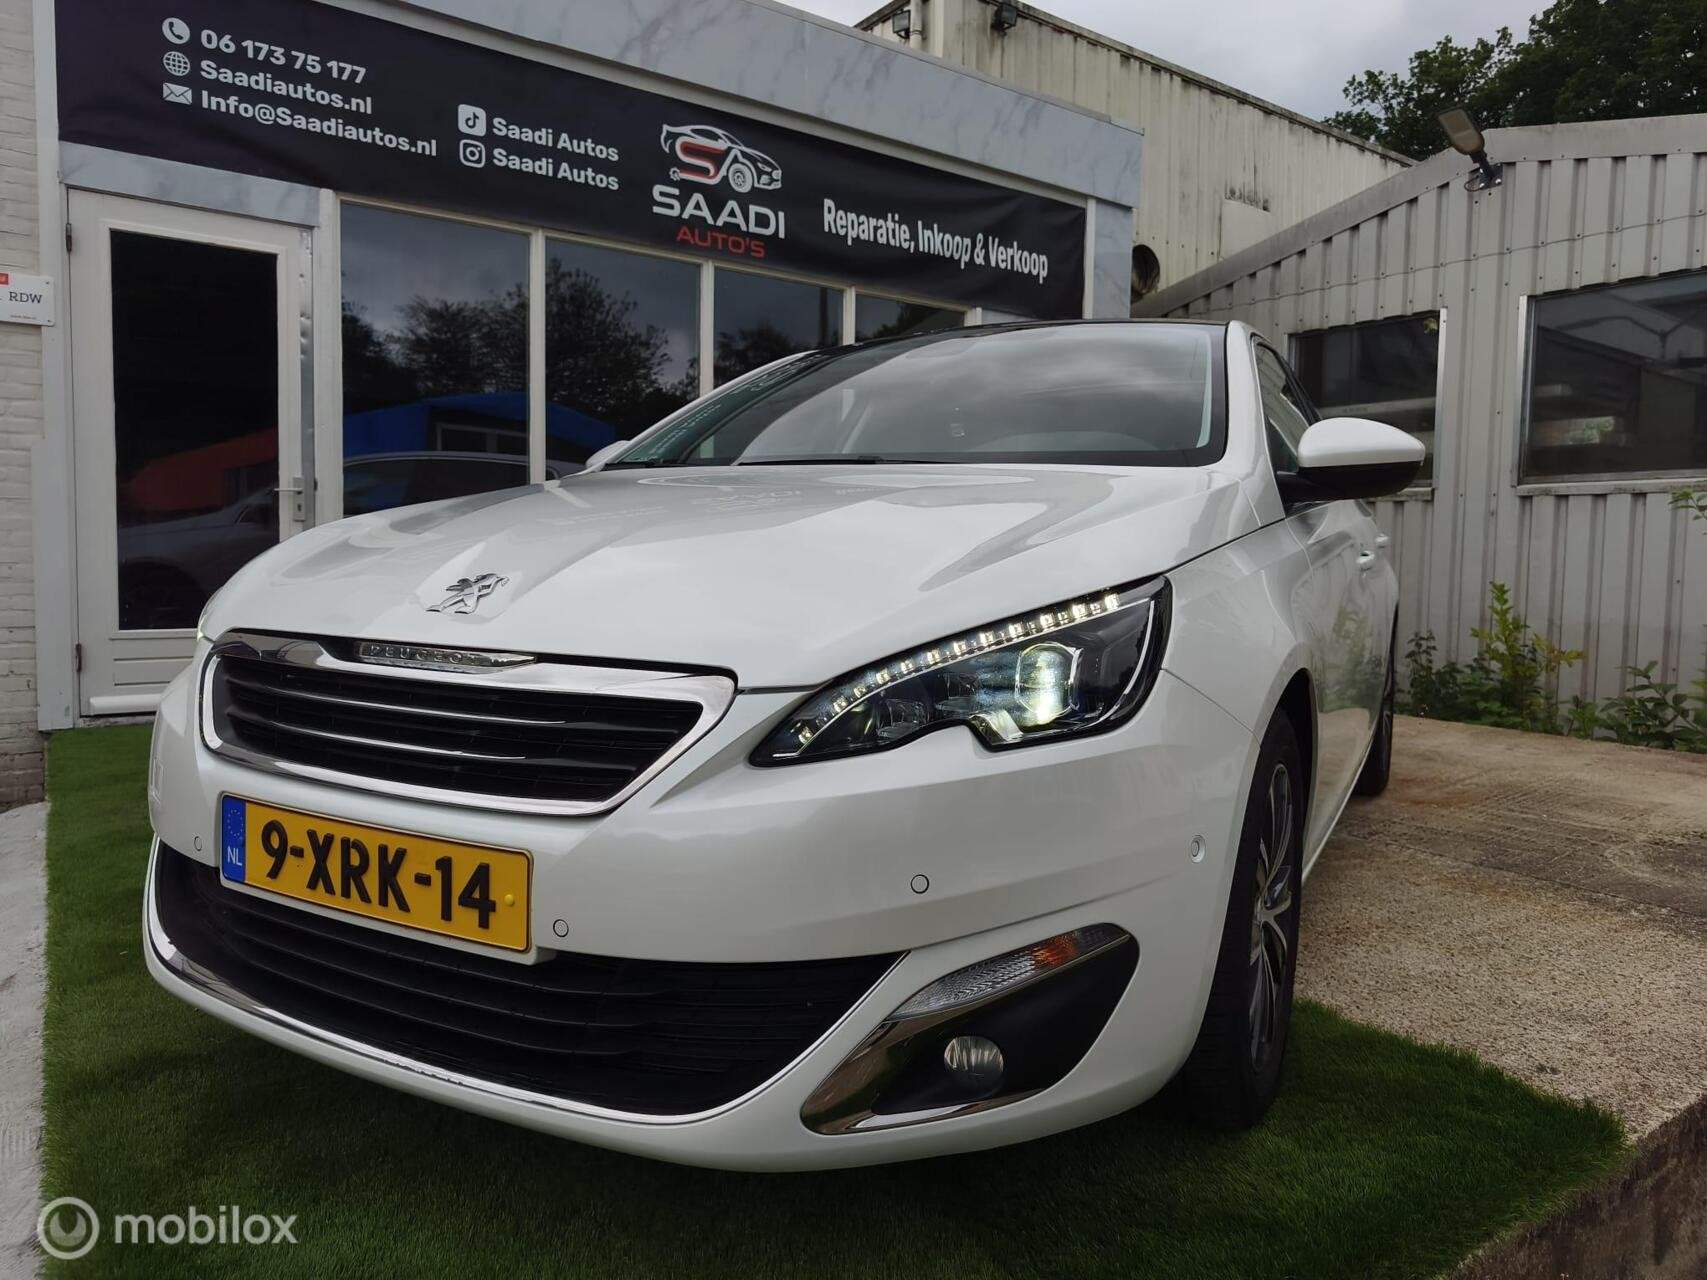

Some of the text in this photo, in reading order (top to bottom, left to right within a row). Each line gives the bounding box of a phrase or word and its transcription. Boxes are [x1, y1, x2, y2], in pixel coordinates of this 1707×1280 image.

[200, 29, 366, 84] 06 173 75 177
[200, 60, 372, 115] Saadiautos.nl
[201, 90, 437, 157] Info@Saadiautos.nl
[492, 117, 619, 162] Saadi Autos
[492, 148, 619, 191] Saadi Autos
[652, 184, 785, 239] SAADI
[676, 225, 766, 259] AUTO'S
[823, 198, 1049, 284] Reparatie, Inkoop & Verkoop
[9, 291, 43, 304] RDW
[227, 845, 243, 866] NL
[261, 819, 496, 930] 9-XRK-14
